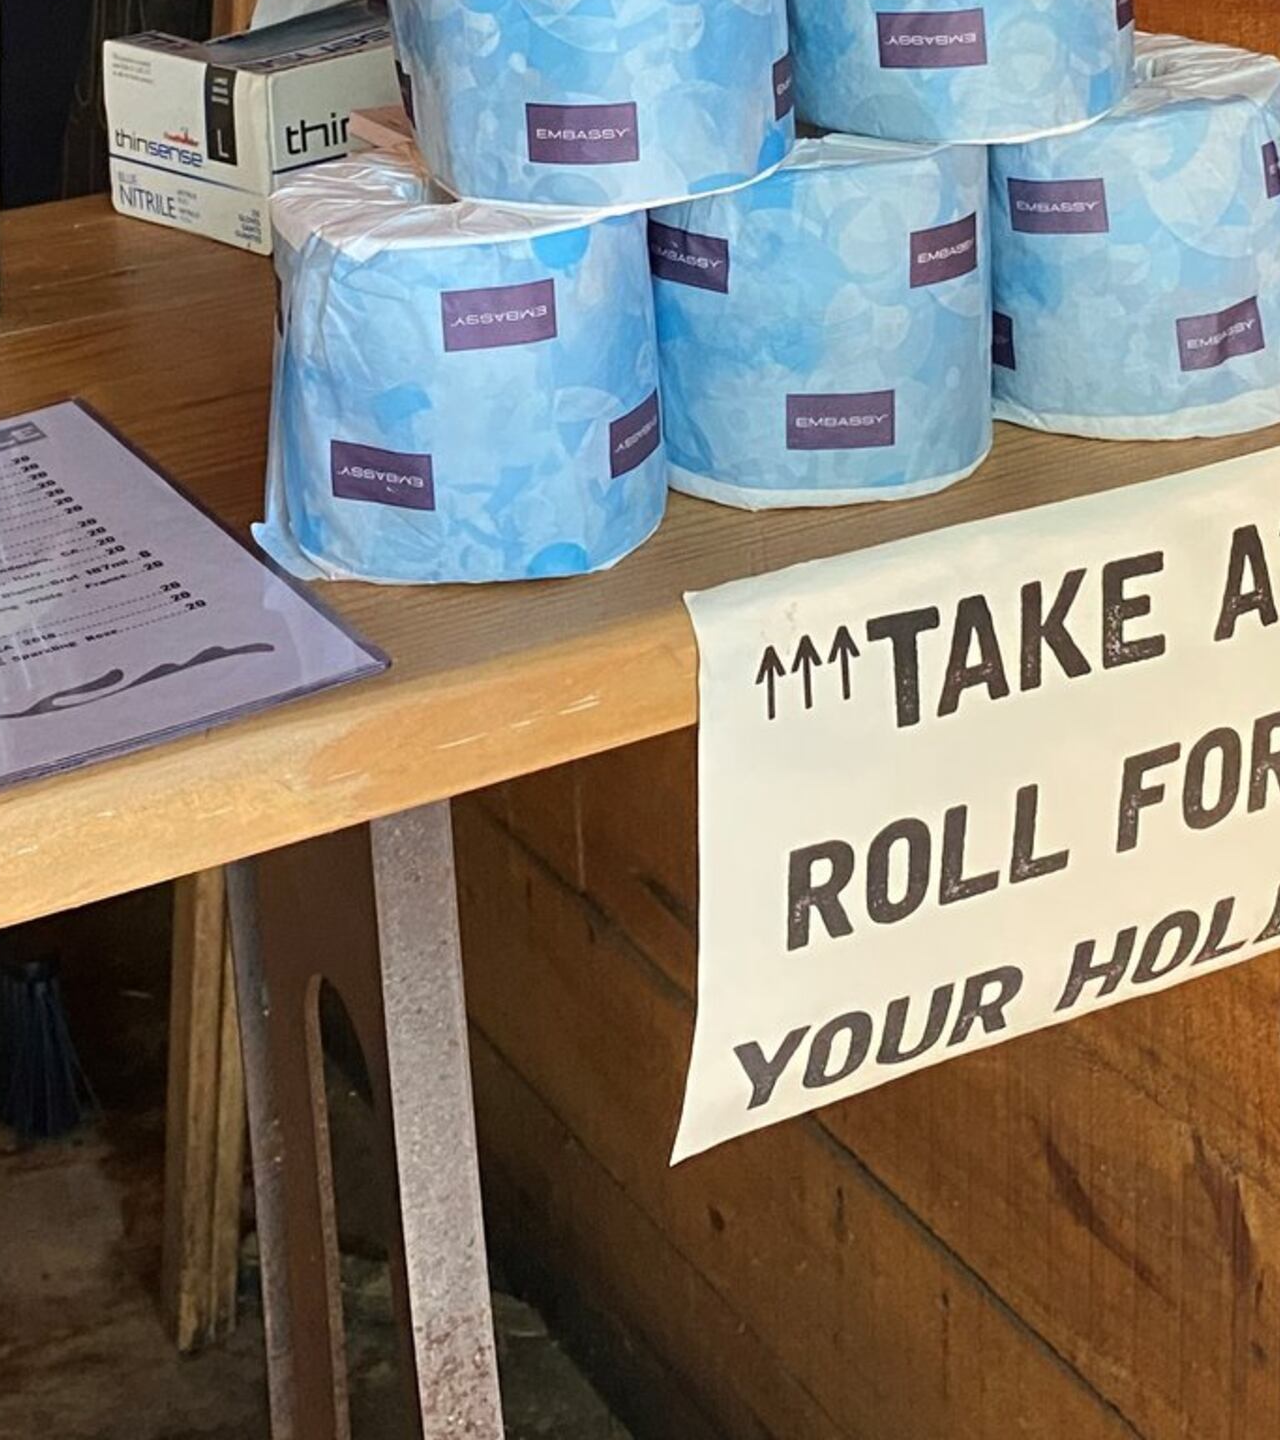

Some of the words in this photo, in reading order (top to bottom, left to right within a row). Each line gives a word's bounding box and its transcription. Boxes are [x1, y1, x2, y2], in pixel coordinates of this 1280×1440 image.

[885, 32, 977, 46] EMBASSY
[115, 127, 204, 168] thinsense
[535, 127, 629, 141] EMBASSY
[119, 184, 177, 219] NITRILE
[1016, 200, 1100, 214] EMBASSY
[450, 303, 549, 327] EMBASSY
[1186, 318, 1256, 349] EMBASSY
[795, 414, 890, 428] EMBASSY
[336, 465, 425, 489] EMBASSY
[866, 549, 1166, 729] TAKE
[1214, 523, 1280, 642] A
[787, 782, 1070, 951] ROLL
[732, 964, 1023, 1111] YOUR
